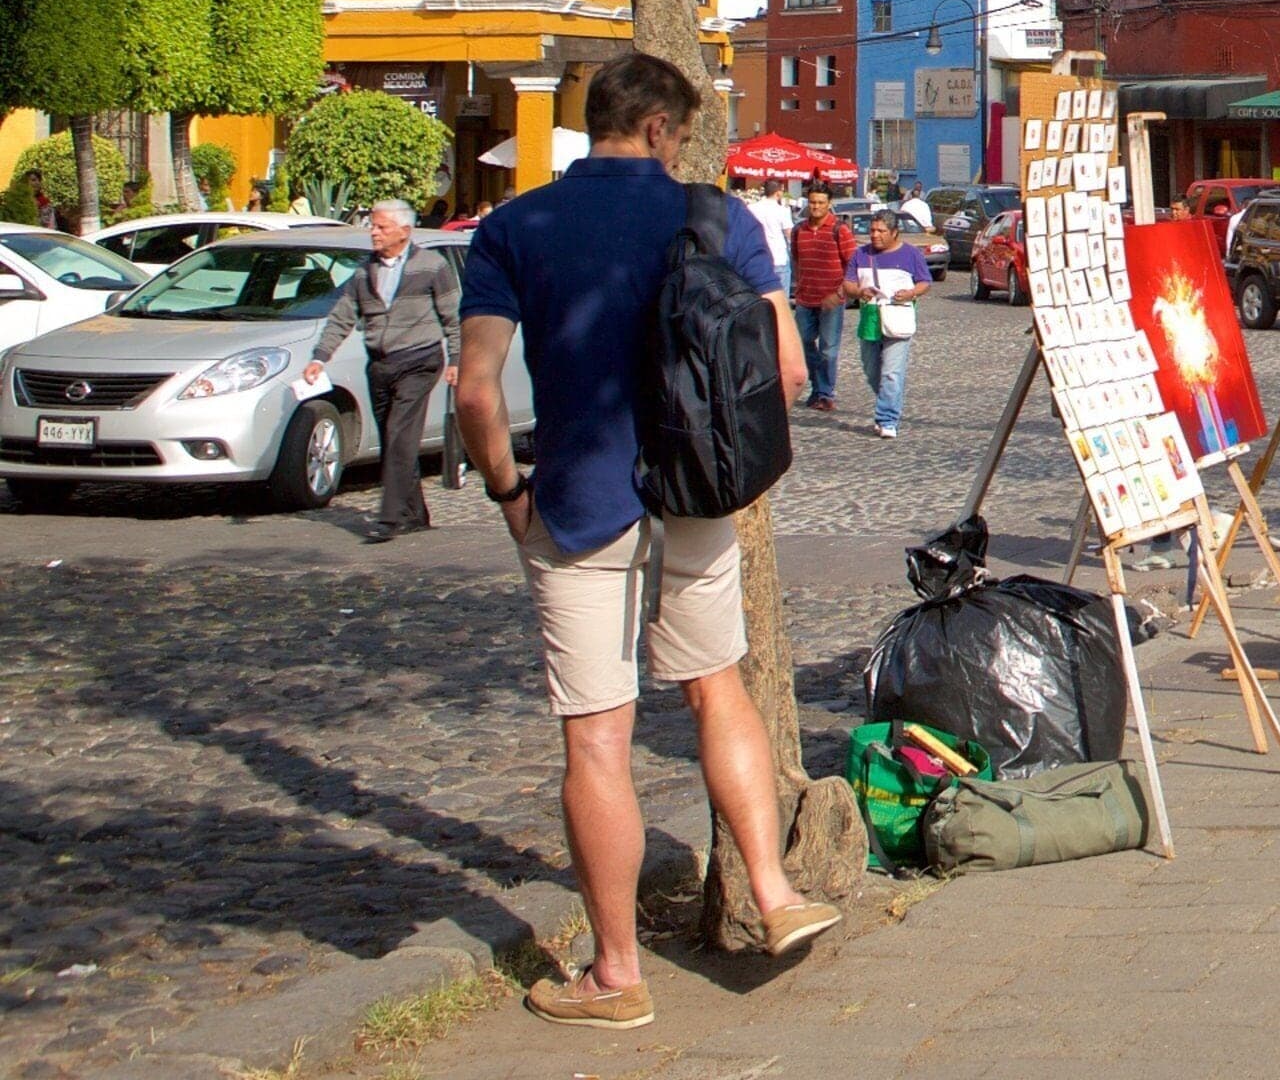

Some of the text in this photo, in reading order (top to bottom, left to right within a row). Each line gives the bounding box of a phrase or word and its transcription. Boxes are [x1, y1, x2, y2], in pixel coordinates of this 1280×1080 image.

[384, 72, 426, 81] COMIDA
[734, 166, 764, 177] Valet
[766, 168, 811, 180] Parking
